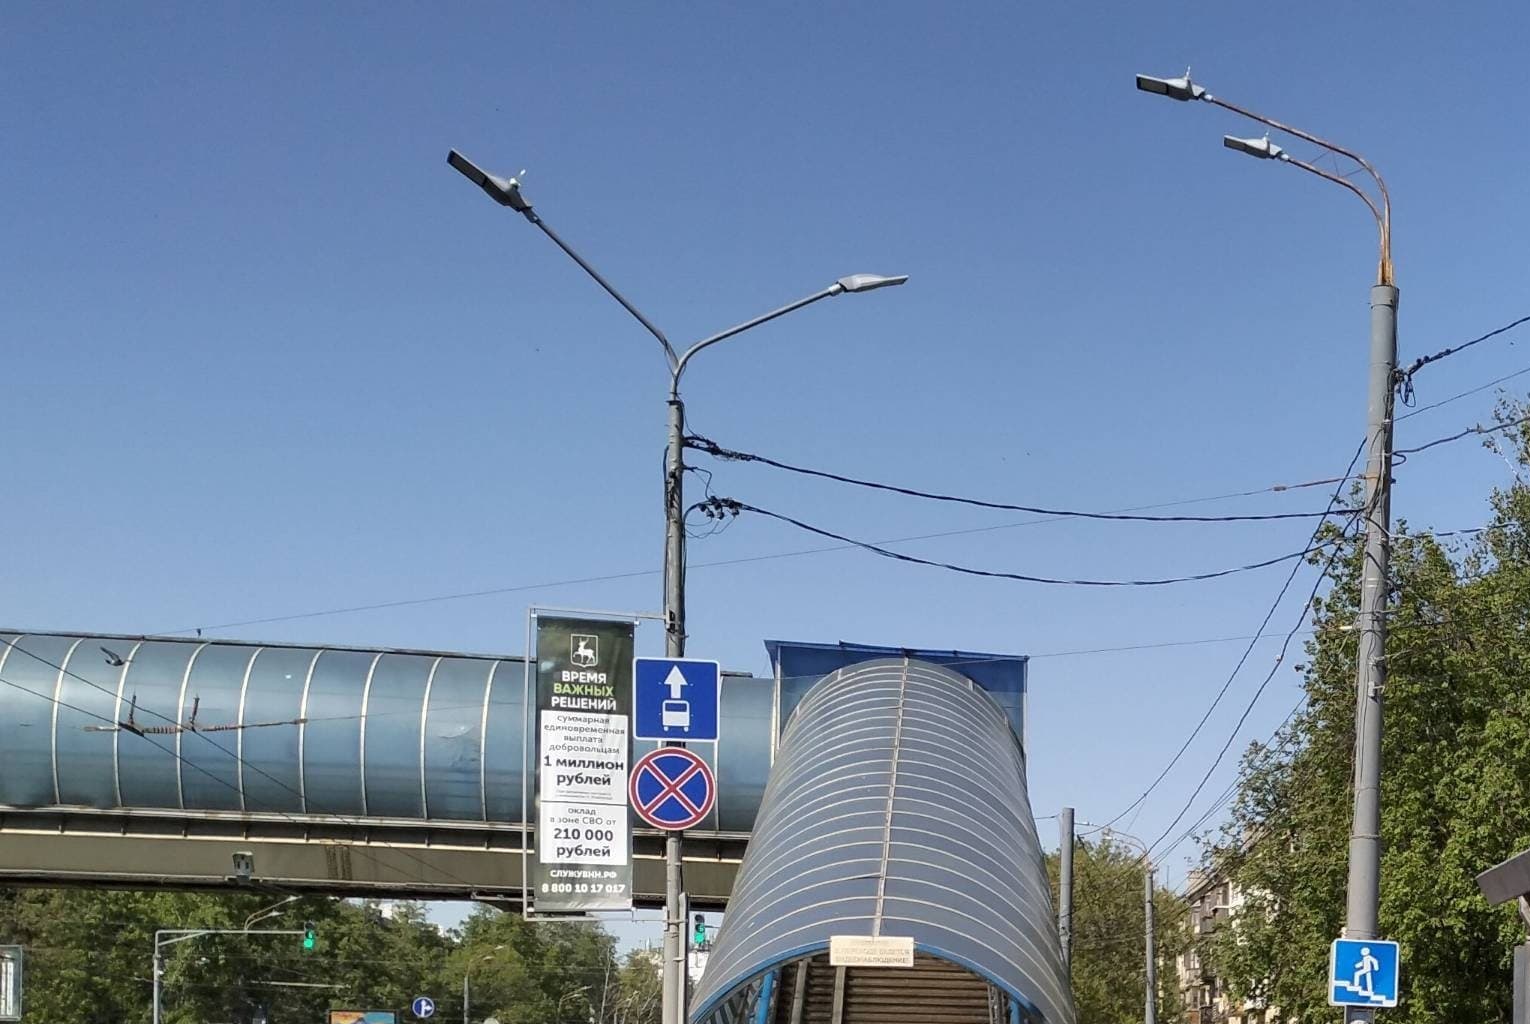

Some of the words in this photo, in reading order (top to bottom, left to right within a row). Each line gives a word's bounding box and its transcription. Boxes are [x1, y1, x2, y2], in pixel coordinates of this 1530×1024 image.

[562, 670, 607, 684] ВРЕМЯ
[553, 683, 614, 697] ВАЖНЫХ
[551, 696, 617, 711] РЕШЕНИЙ
[557, 714, 610, 725] суммарная
[544, 724, 625, 735] единовременная
[563, 735, 603, 744] выплата
[549, 743, 620, 754] добровольцам
[543, 754, 552, 767] 1
[556, 758, 624, 770] миллион
[556, 772, 611, 786] рублей
[567, 807, 596, 815] оклад
[582, 816, 603, 825] СВО
[554, 827, 581, 840] 210
[585, 829, 614, 841] 000
[556, 844, 611, 858] рублей
[541, 883, 549, 893] 8
[551, 883, 572, 893] 800
[574, 883, 588, 893] 10
[590, 884, 603, 893] 17
[605, 884, 626, 893] 017
